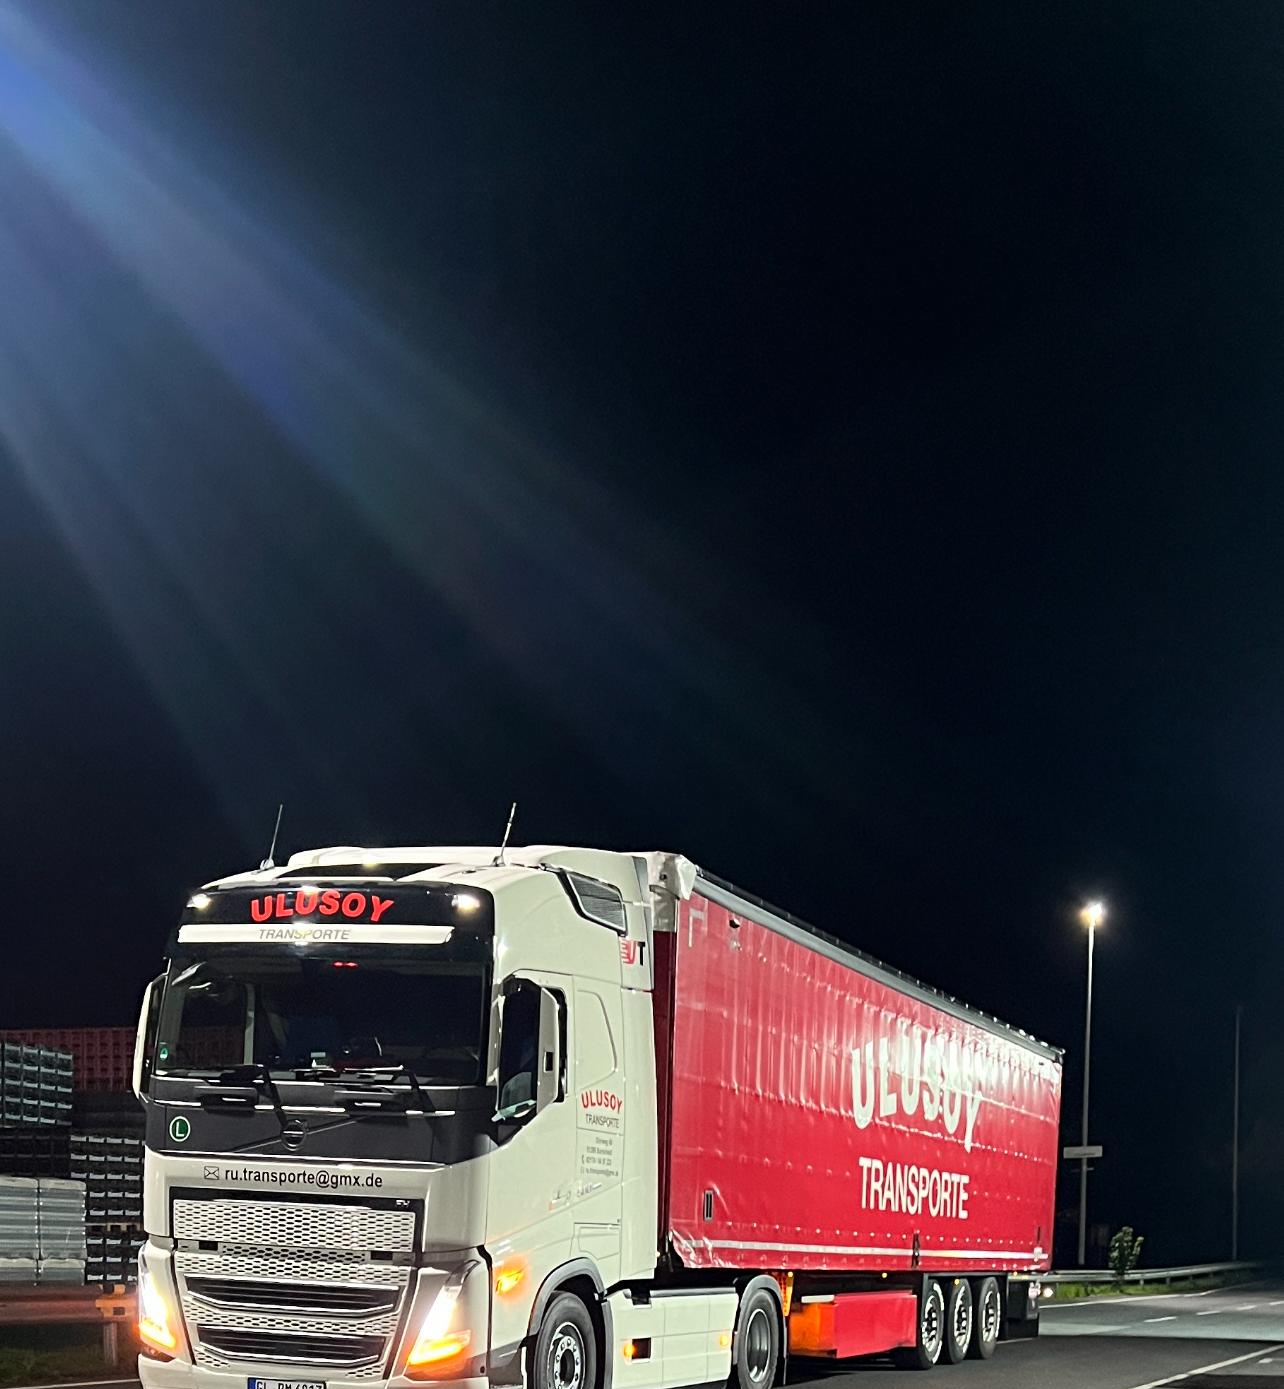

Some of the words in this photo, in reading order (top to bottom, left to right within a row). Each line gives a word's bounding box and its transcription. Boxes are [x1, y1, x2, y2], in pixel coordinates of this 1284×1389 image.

[250, 889, 394, 922] ULUSOY
[258, 928, 351, 940] TRANSPORTE
[581, 1090, 623, 1114] ULUSOY
[851, 1028, 982, 1153] ULUSOY
[585, 1113, 620, 1129] TRANSPORTE
[225, 1168, 383, 1189] ru.transporte@gmx.de
[858, 1156, 970, 1219] TRANSPORTE
